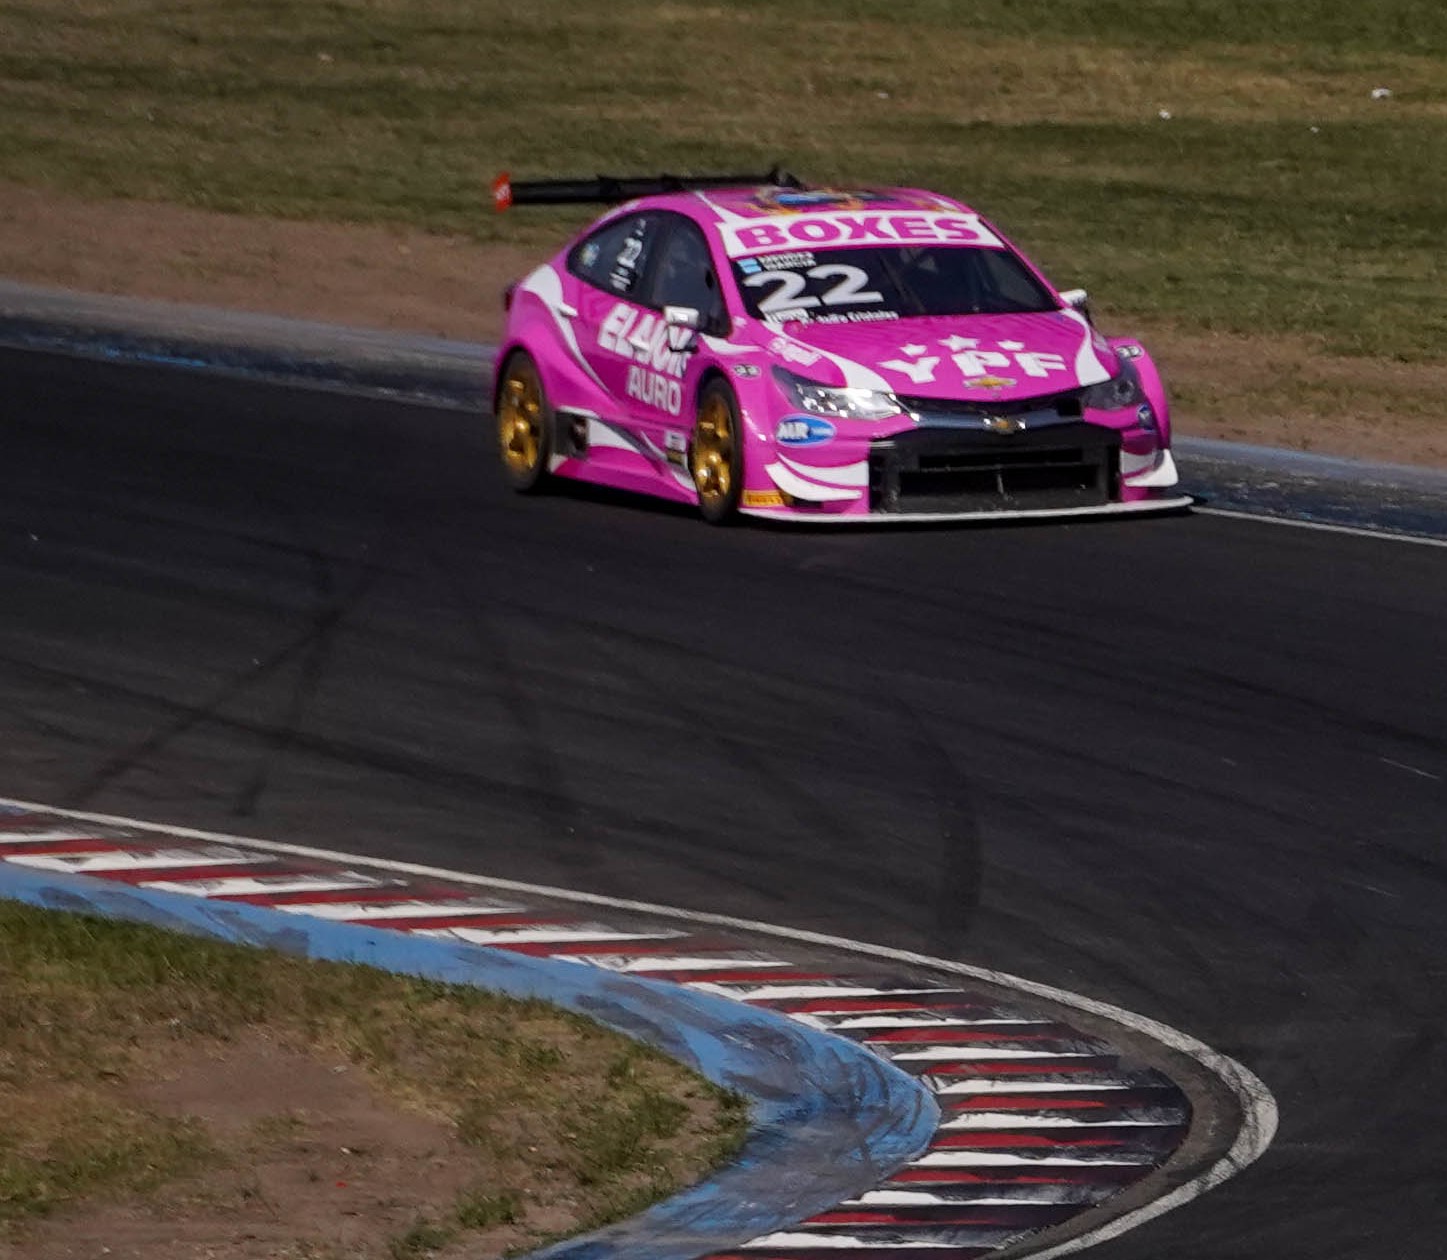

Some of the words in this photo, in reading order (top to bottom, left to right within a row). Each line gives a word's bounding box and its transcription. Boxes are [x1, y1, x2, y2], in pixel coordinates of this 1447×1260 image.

[735, 216, 981, 251] BOXES
[743, 264, 884, 314] 22
[879, 350, 1067, 384] YPF
[625, 366, 682, 416] AURO
